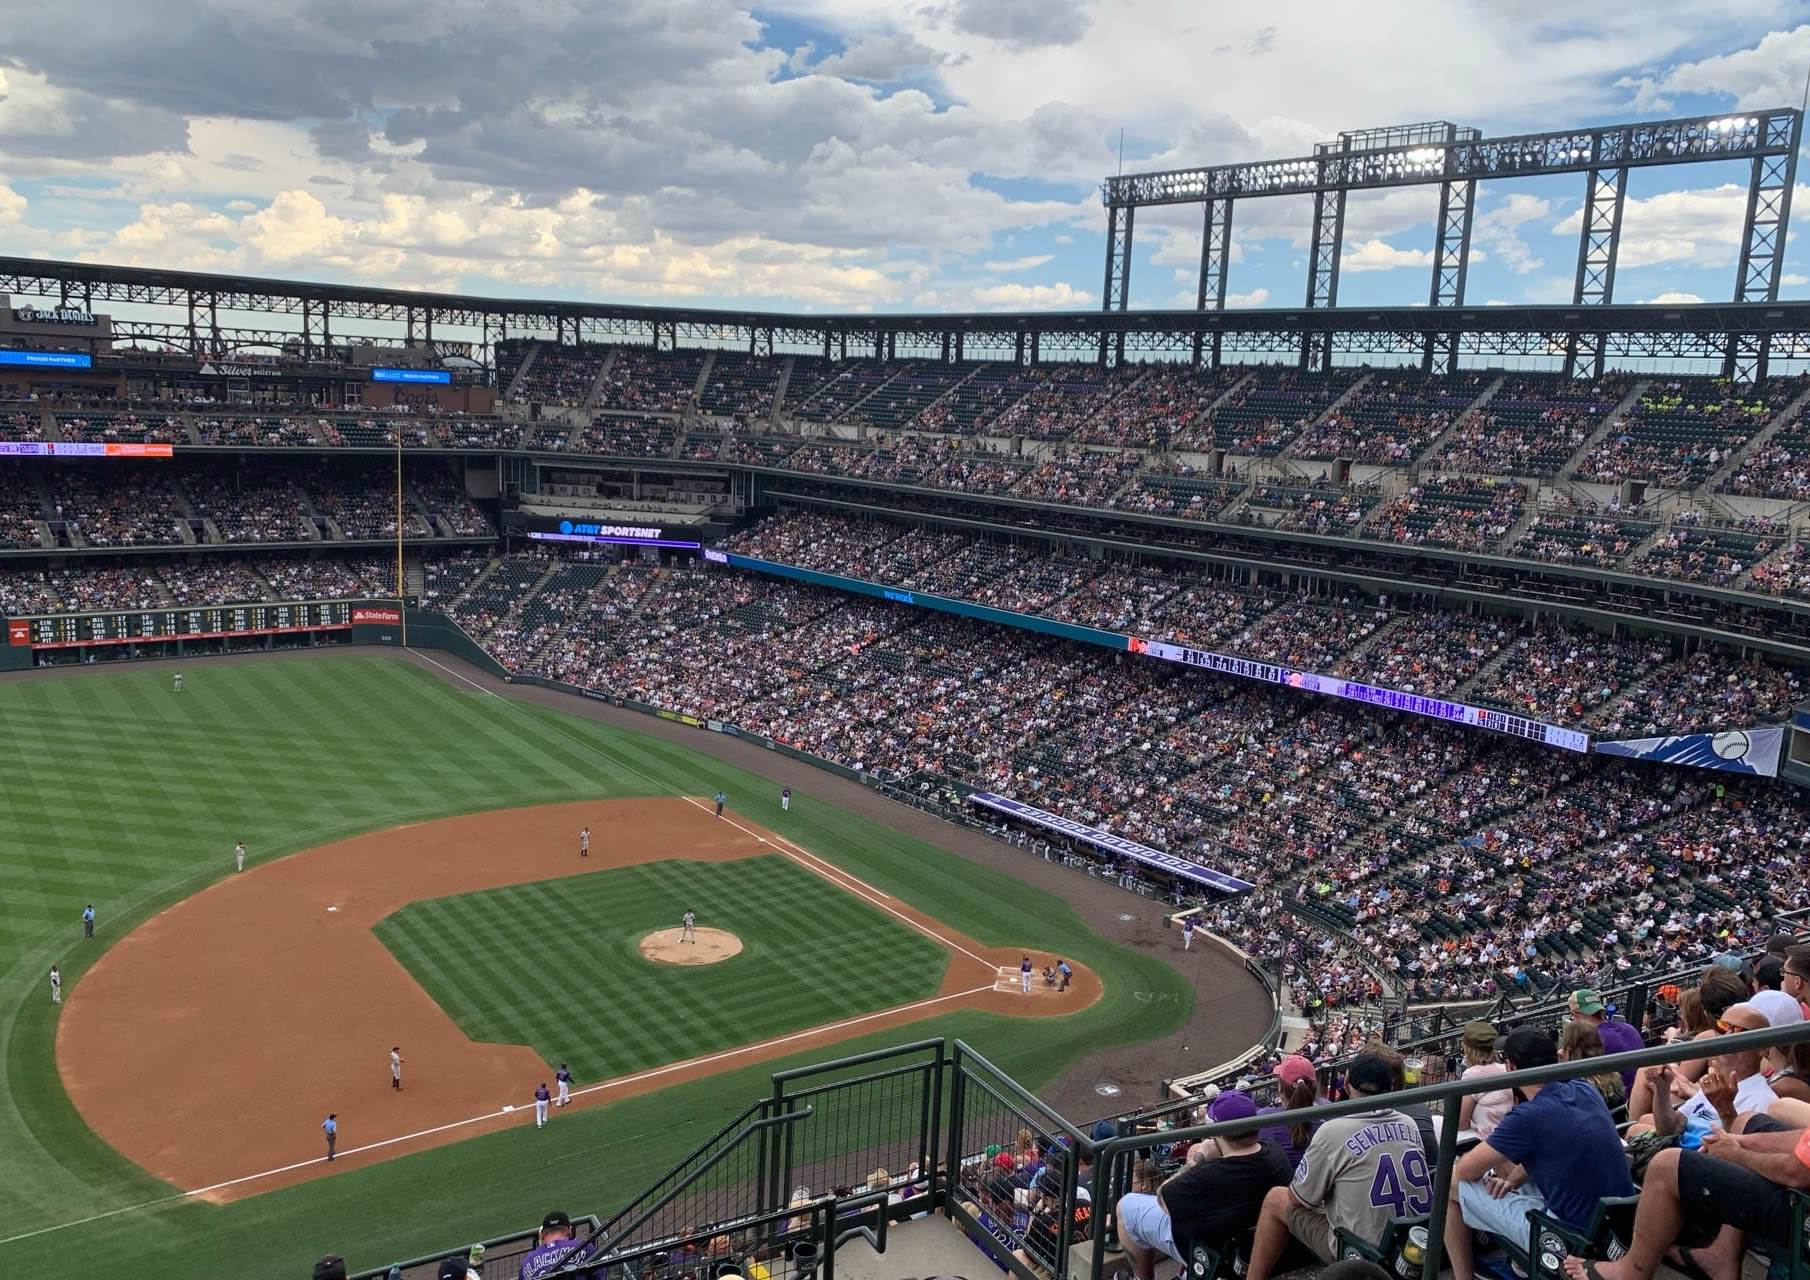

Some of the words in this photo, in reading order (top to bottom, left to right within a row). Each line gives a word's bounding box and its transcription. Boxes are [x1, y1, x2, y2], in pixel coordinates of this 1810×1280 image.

[36, 309, 58, 320] JACK
[219, 365, 251, 376] Silver
[573, 524, 600, 534] AT&T
[600, 526, 662, 538] SPORTSNET
[884, 590, 914, 604] wework
[1017, 806, 1092, 836] ROCKIES
[1092, 832, 1195, 871] COLORADO
[1344, 1121, 1422, 1158] SENZATELA
[1369, 1148, 1433, 1217] 49
